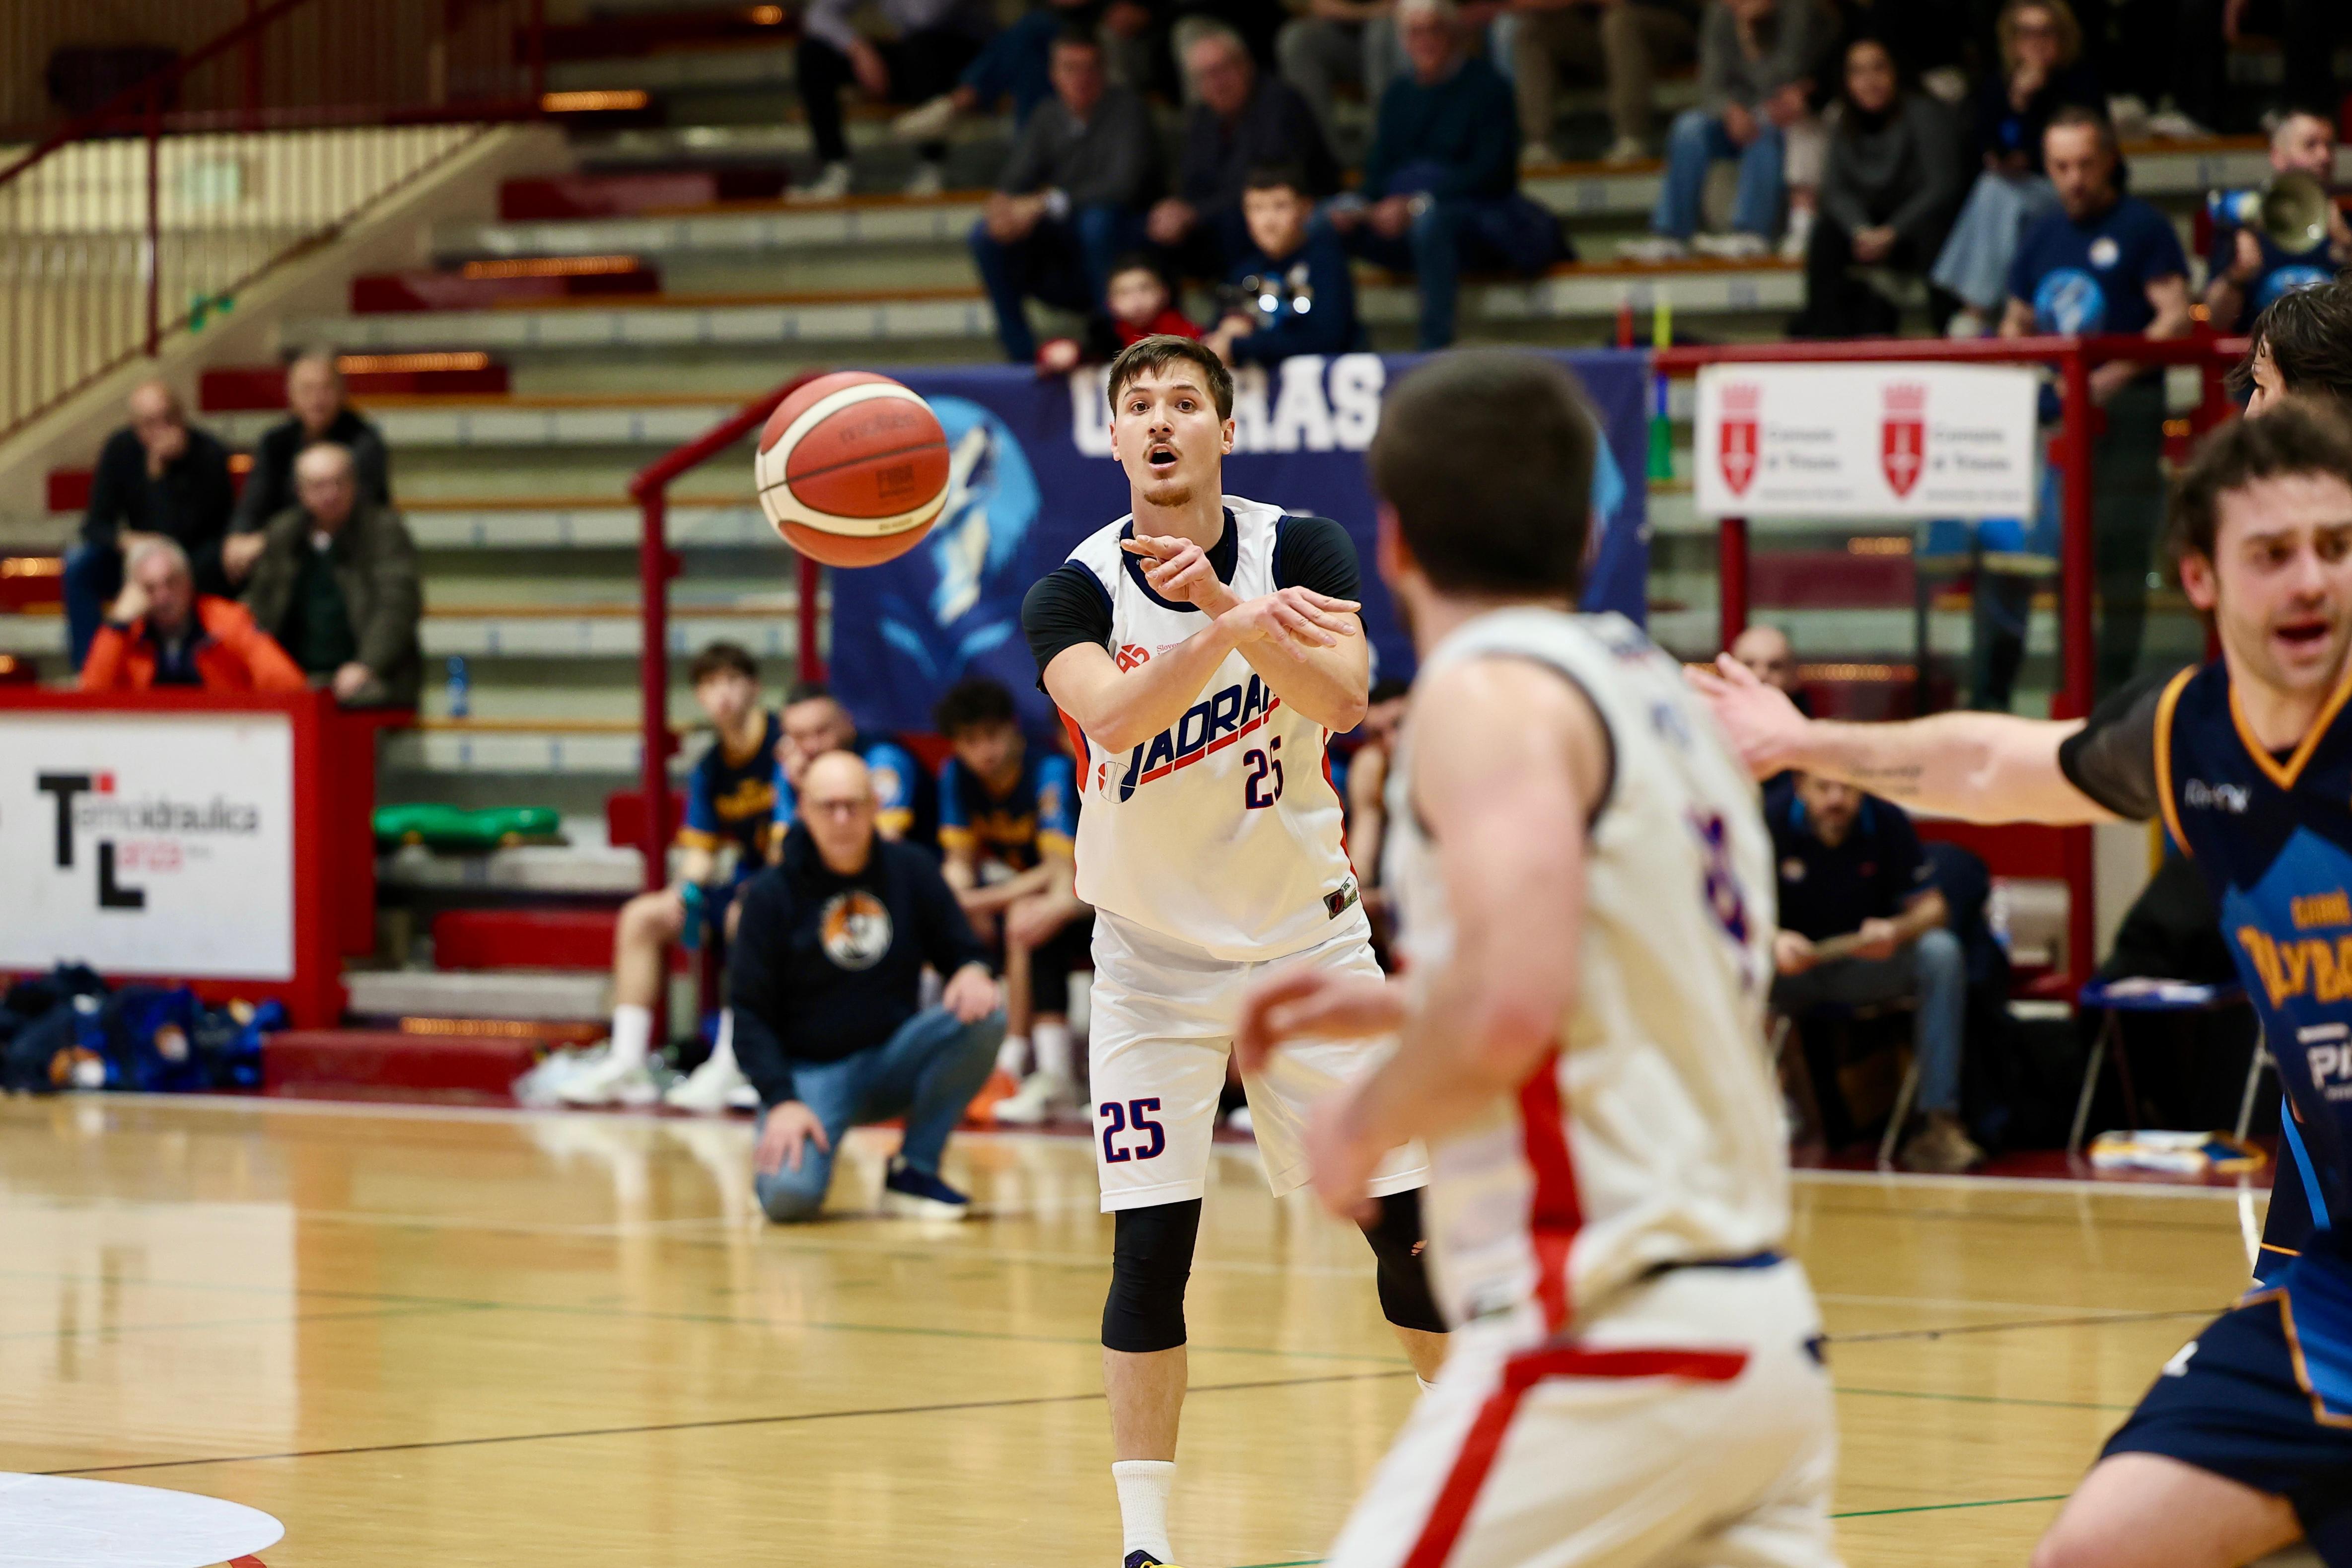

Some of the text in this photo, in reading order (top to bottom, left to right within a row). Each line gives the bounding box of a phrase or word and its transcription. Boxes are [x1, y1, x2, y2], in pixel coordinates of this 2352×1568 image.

[1069, 353, 1387, 458] URAS
[1156, 643, 1180, 652] Slove
[1243, 736, 1284, 810] 25
[1100, 1097, 1165, 1163] 25
